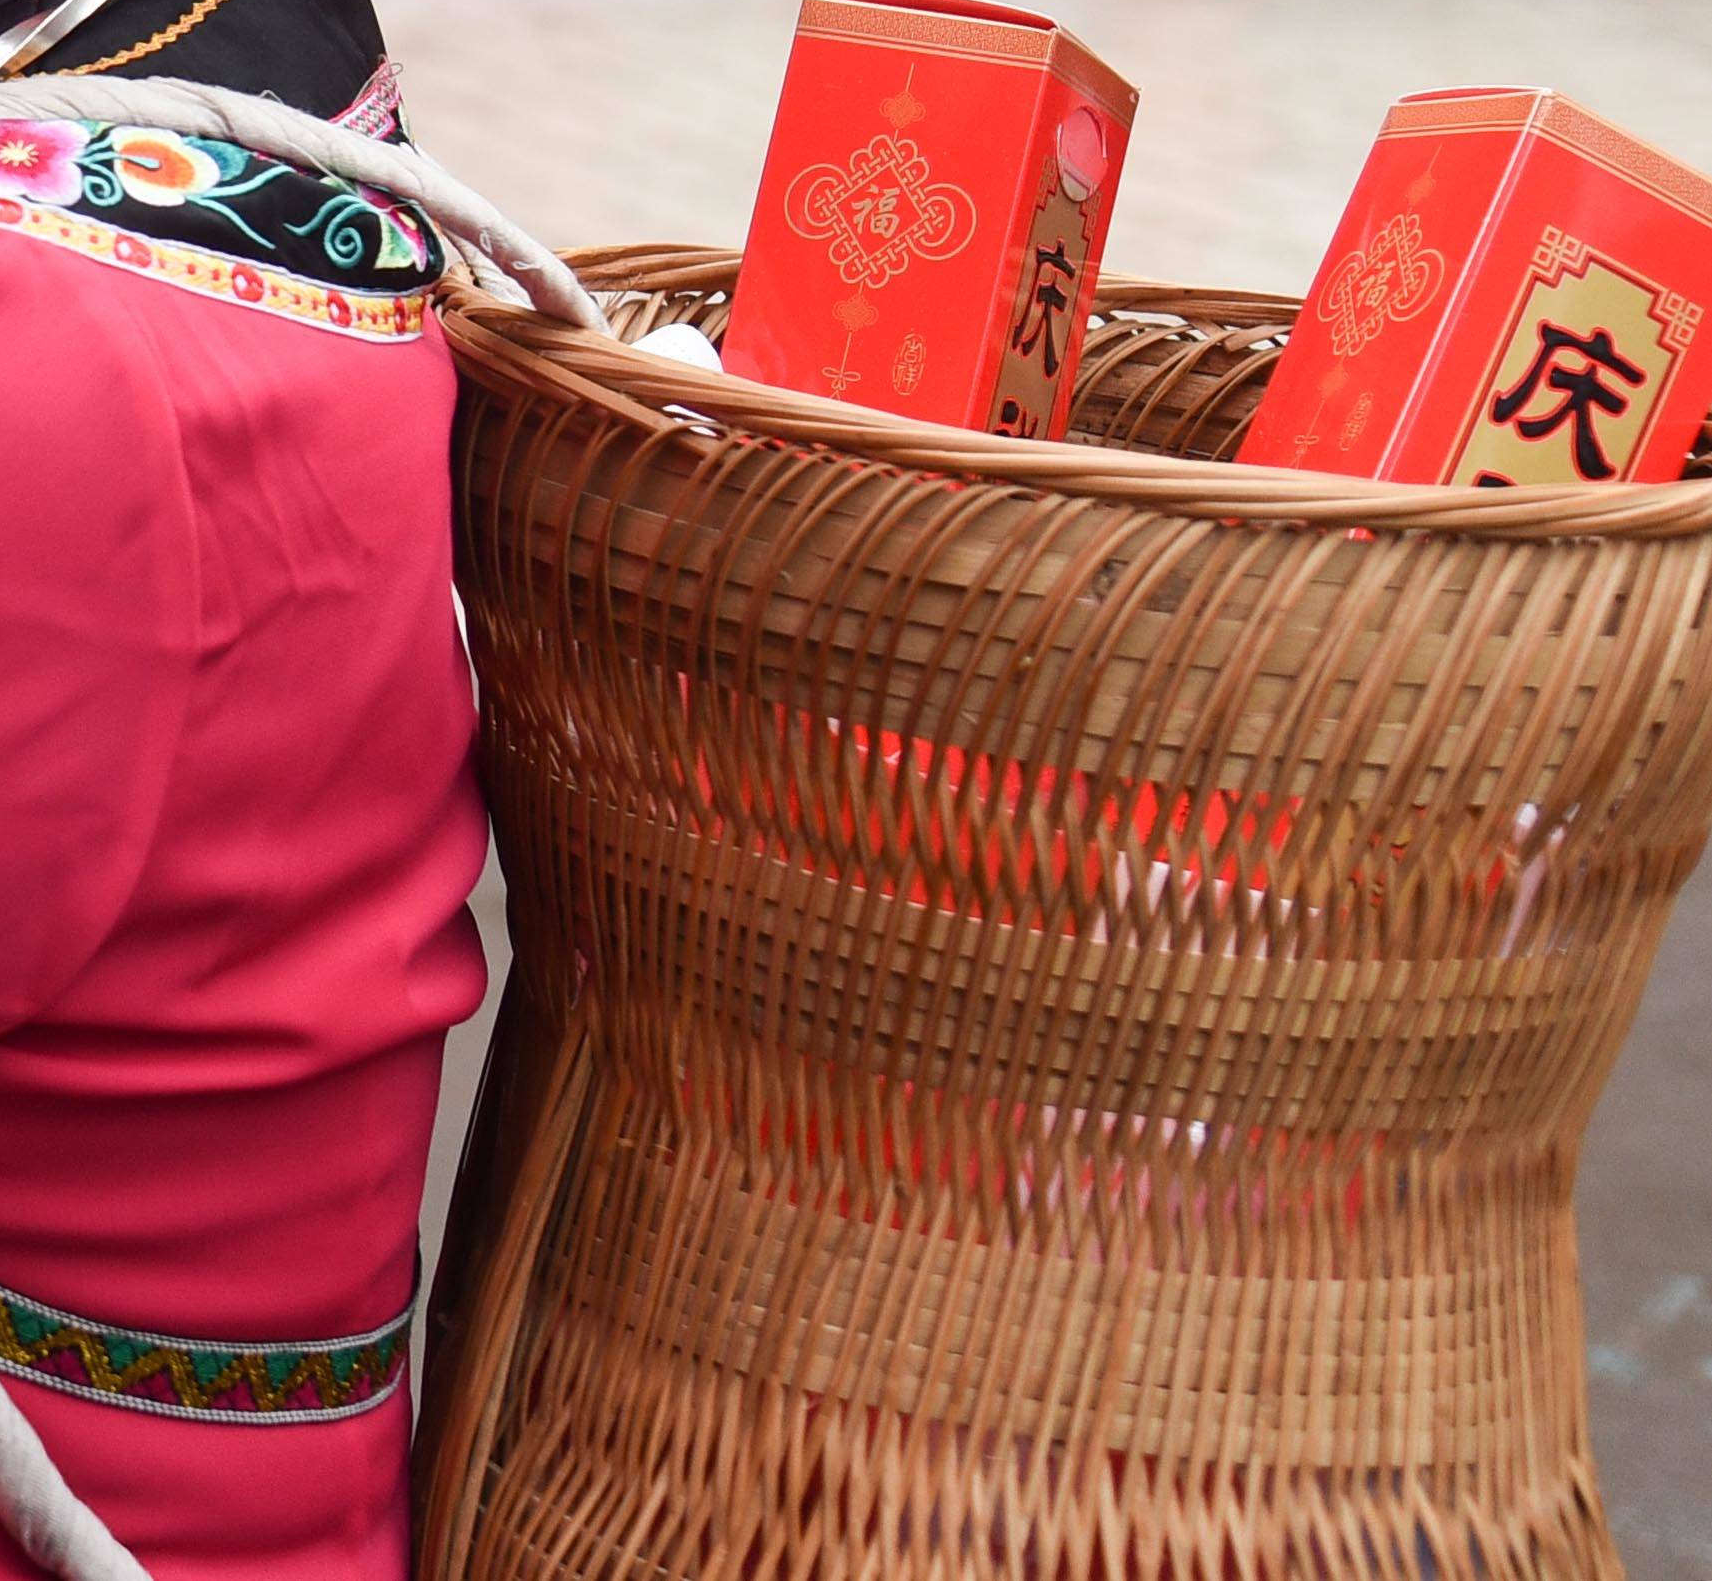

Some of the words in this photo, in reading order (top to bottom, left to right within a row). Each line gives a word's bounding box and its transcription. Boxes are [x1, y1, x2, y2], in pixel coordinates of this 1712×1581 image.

[851, 185, 900, 238] 福
[1357, 260, 1396, 308] 福
[897, 339, 923, 391] 吉祥
